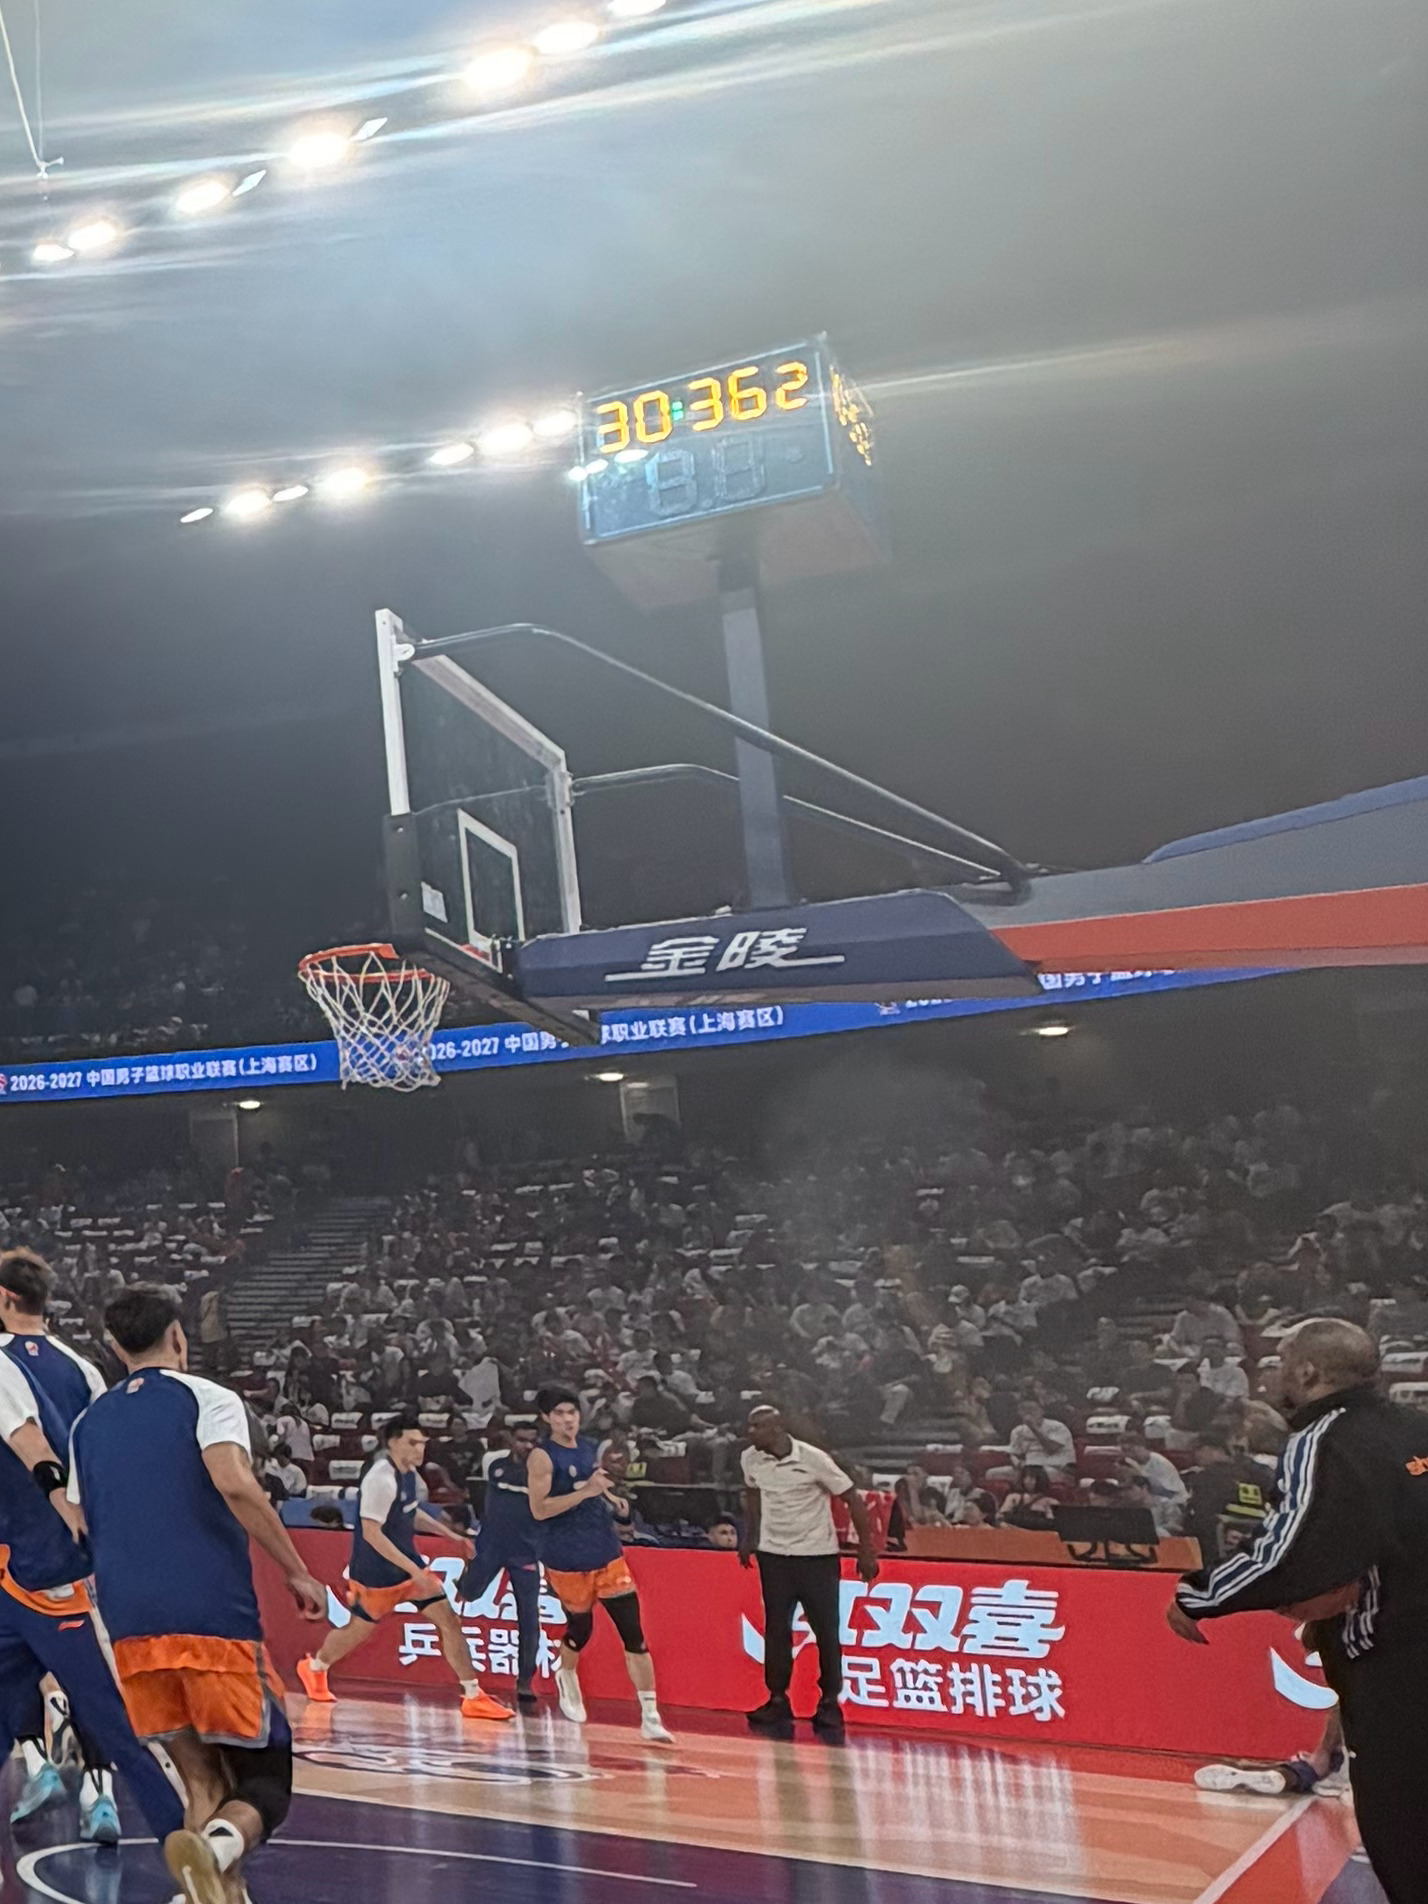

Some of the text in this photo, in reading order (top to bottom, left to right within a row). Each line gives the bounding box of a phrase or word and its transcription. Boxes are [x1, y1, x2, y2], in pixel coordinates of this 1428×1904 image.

[605, 928, 845, 982] 金陵
[425, 1036, 500, 1061] 26-2027
[10, 1072, 82, 1093] 2026-2027
[840, 1654, 1066, 1722] 足篮排球
